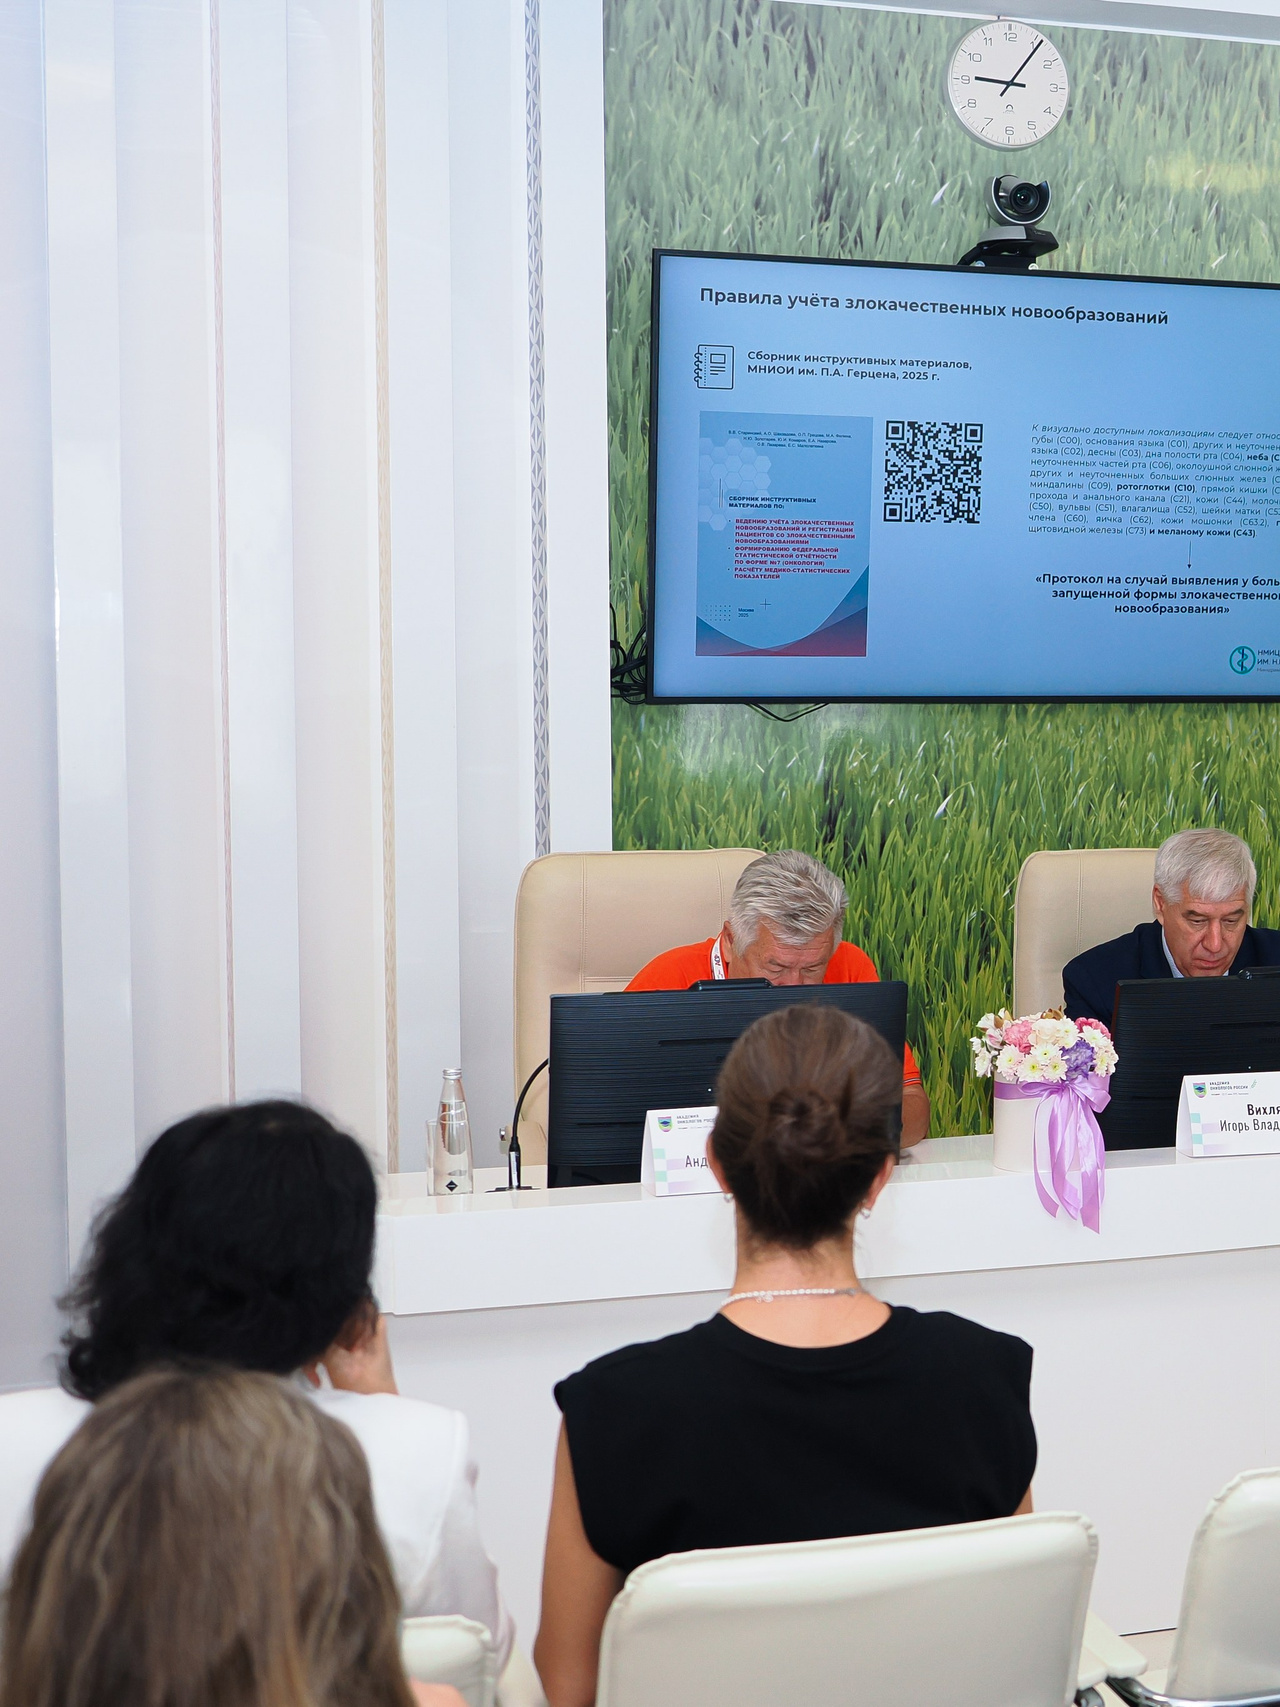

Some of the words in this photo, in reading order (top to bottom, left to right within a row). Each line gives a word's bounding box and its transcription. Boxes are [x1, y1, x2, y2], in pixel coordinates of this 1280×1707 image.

[984, 38, 992, 46] 11
[1004, 33, 1017, 42] 12
[968, 53, 982, 62] 10
[1043, 60, 1052, 69] 2
[961, 75, 970, 84] 9
[1050, 84, 1058, 92] 3
[968, 99, 976, 108] 8
[984, 118, 993, 126] 7
[1028, 121, 1036, 130] 5
[1005, 126, 1014, 136] 6
[700, 288, 782, 309] Правила
[787, 292, 839, 312] учёта
[844, 298, 1006, 317] злокачественных
[1011, 303, 1168, 328] новообразований
[747, 351, 801, 364] Сборник
[803, 355, 896, 368] инструктивных
[899, 359, 972, 371] материалов,
[747, 365, 794, 376] МНИОИ
[797, 368, 817, 376] им.
[820, 367, 844, 377] П.А.
[847, 368, 899, 381] Герцена,
[901, 370, 928, 380] 2025
[1032, 424, 1039, 432] К
[1042, 426, 1090, 435] визуально
[1093, 427, 1144, 437] доступным
[1147, 429, 1215, 439] локализациям
[1218, 431, 1253, 441] следует
[1031, 435, 1053, 445] губы
[1193, 442, 1223, 451] других
[1087, 450, 1116, 458] десны
[1145, 451, 1162, 460] дна
[1203, 453, 1218, 461] рта
[1247, 452, 1268, 461] неба
[1031, 459, 1096, 469] неуточненных
[1099, 459, 1129, 468] частей
[1132, 462, 1146, 470] рта
[1176, 461, 1231, 472] околоушной
[1234, 463, 1273, 472] слюнной
[1030, 470, 1062, 479] других
[1080, 471, 1144, 481] неуточненных
[1150, 471, 1189, 480] больших
[1030, 482, 1084, 491] миндалины
[1116, 484, 1170, 493] ротоглотки
[1201, 484, 1235, 495] прямой
[1030, 493, 1068, 502] прохода
[1058, 504, 1090, 513] вульвы
[1121, 506, 1170, 515] влагалища
[1201, 505, 1230, 514] шейки
[1028, 525, 1086, 535] щитовидной
[1157, 528, 1204, 537] меланому
[1035, 574, 1103, 586] «Протокол
[1124, 575, 1167, 587] случай
[1171, 577, 1238, 586] выявления
[1241, 578, 1249, 588] у
[1051, 588, 1130, 601] запущенной
[1133, 589, 1177, 601] формы
[1114, 604, 1230, 616] новообразования»
[1220, 1119, 1250, 1133] Игорь
[685, 1155, 708, 1168] Анд
